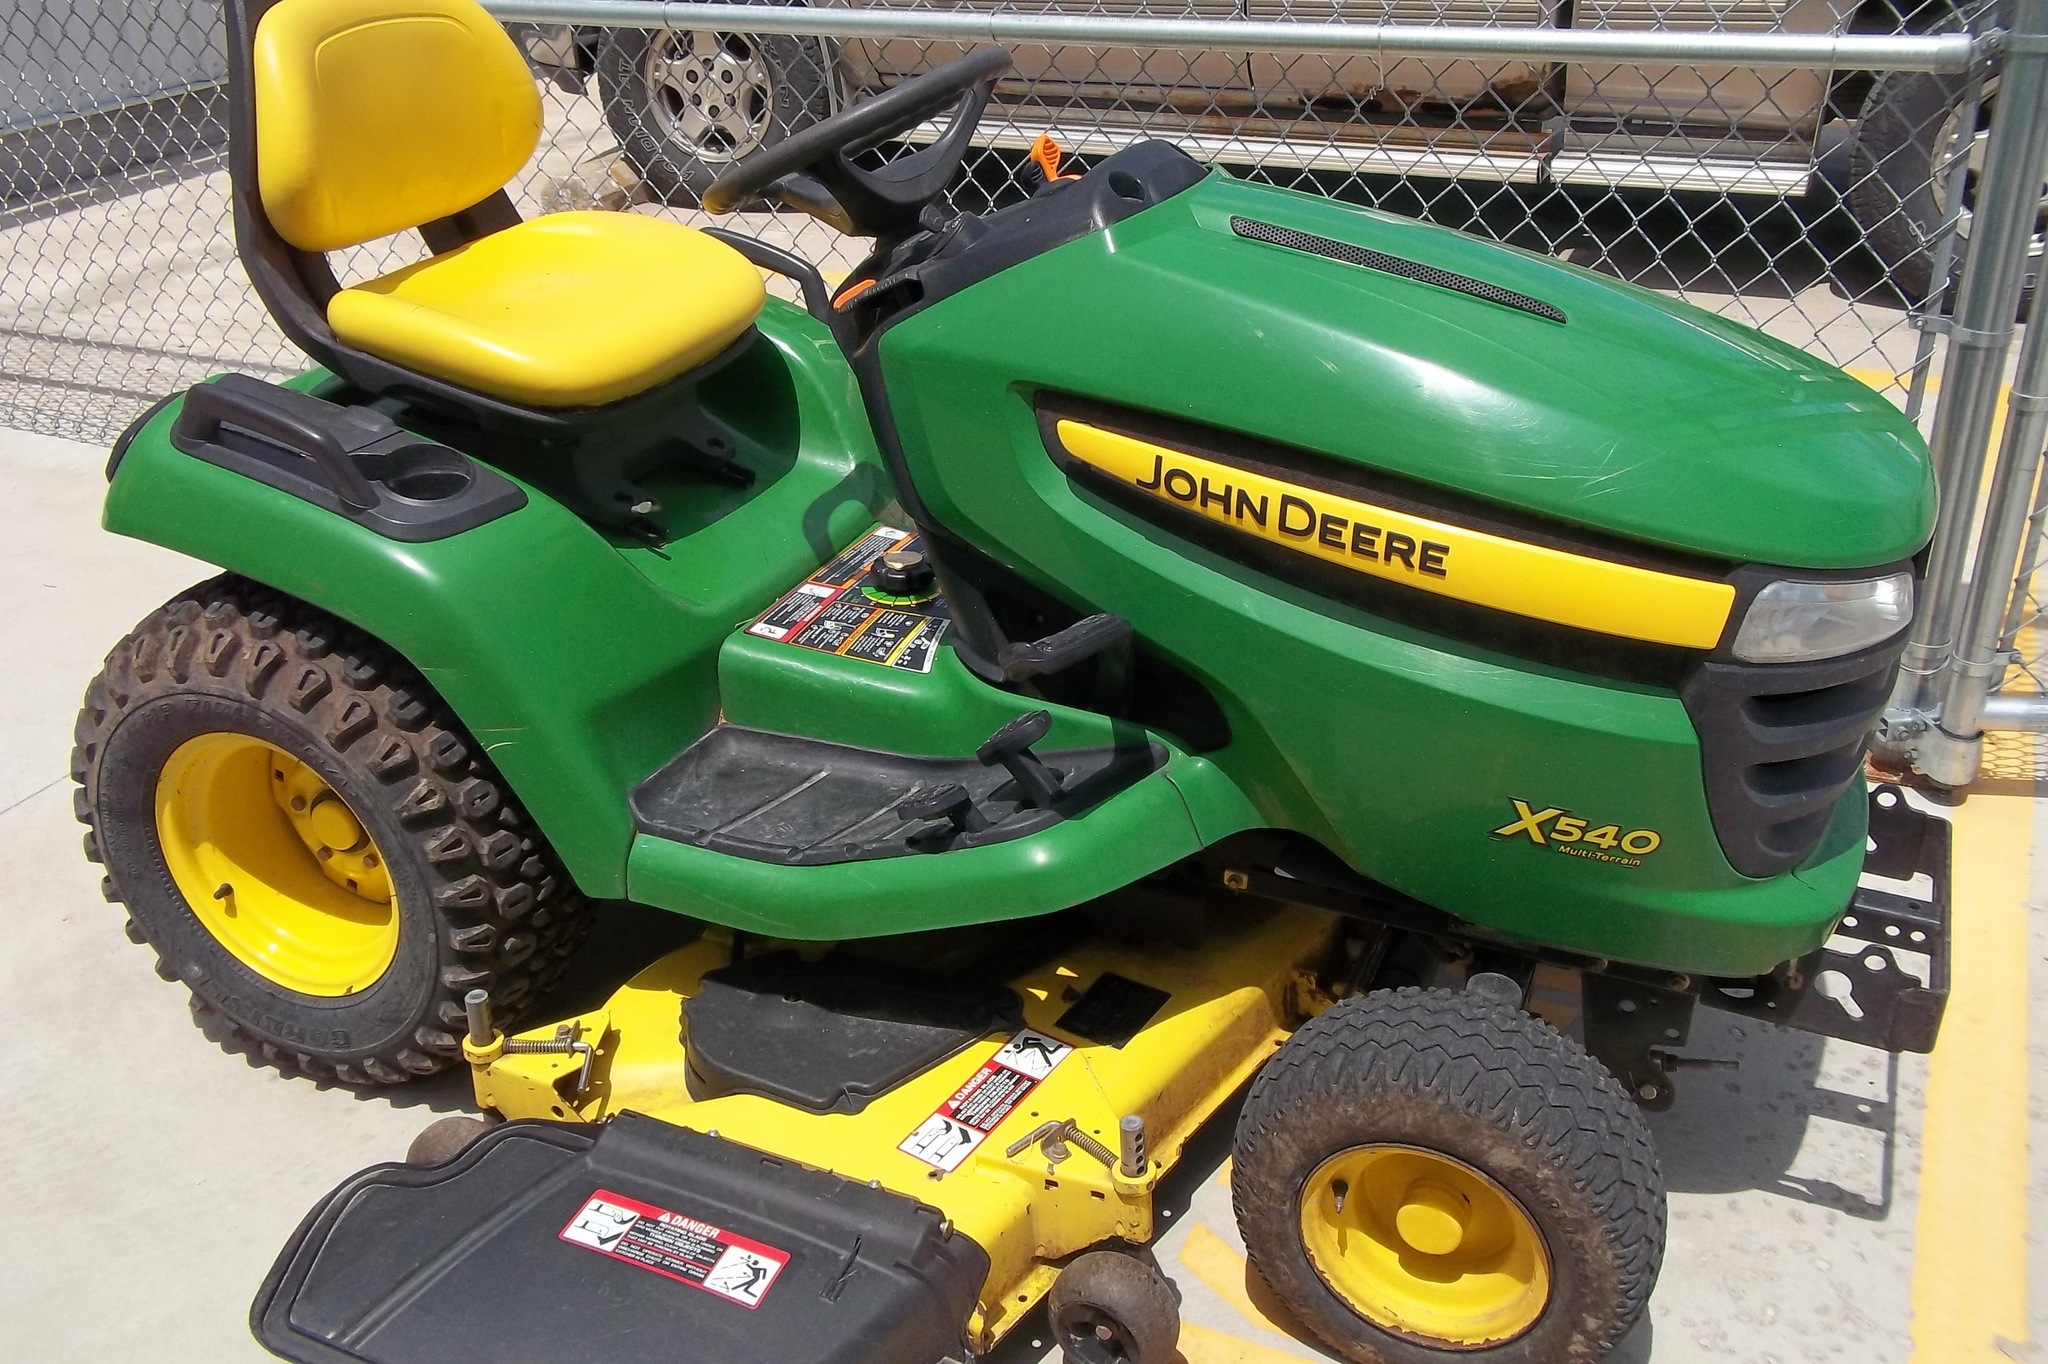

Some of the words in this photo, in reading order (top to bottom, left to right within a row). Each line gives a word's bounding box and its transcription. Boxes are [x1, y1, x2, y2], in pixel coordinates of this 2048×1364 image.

[1136, 455, 1268, 526] JOHN
[1278, 494, 1450, 577] DEERE
[1492, 798, 1662, 855] X540
[1558, 844, 1641, 867] Multi-Terrain
[954, 1067, 993, 1101] DANGER
[672, 1214, 720, 1240] DANGER
